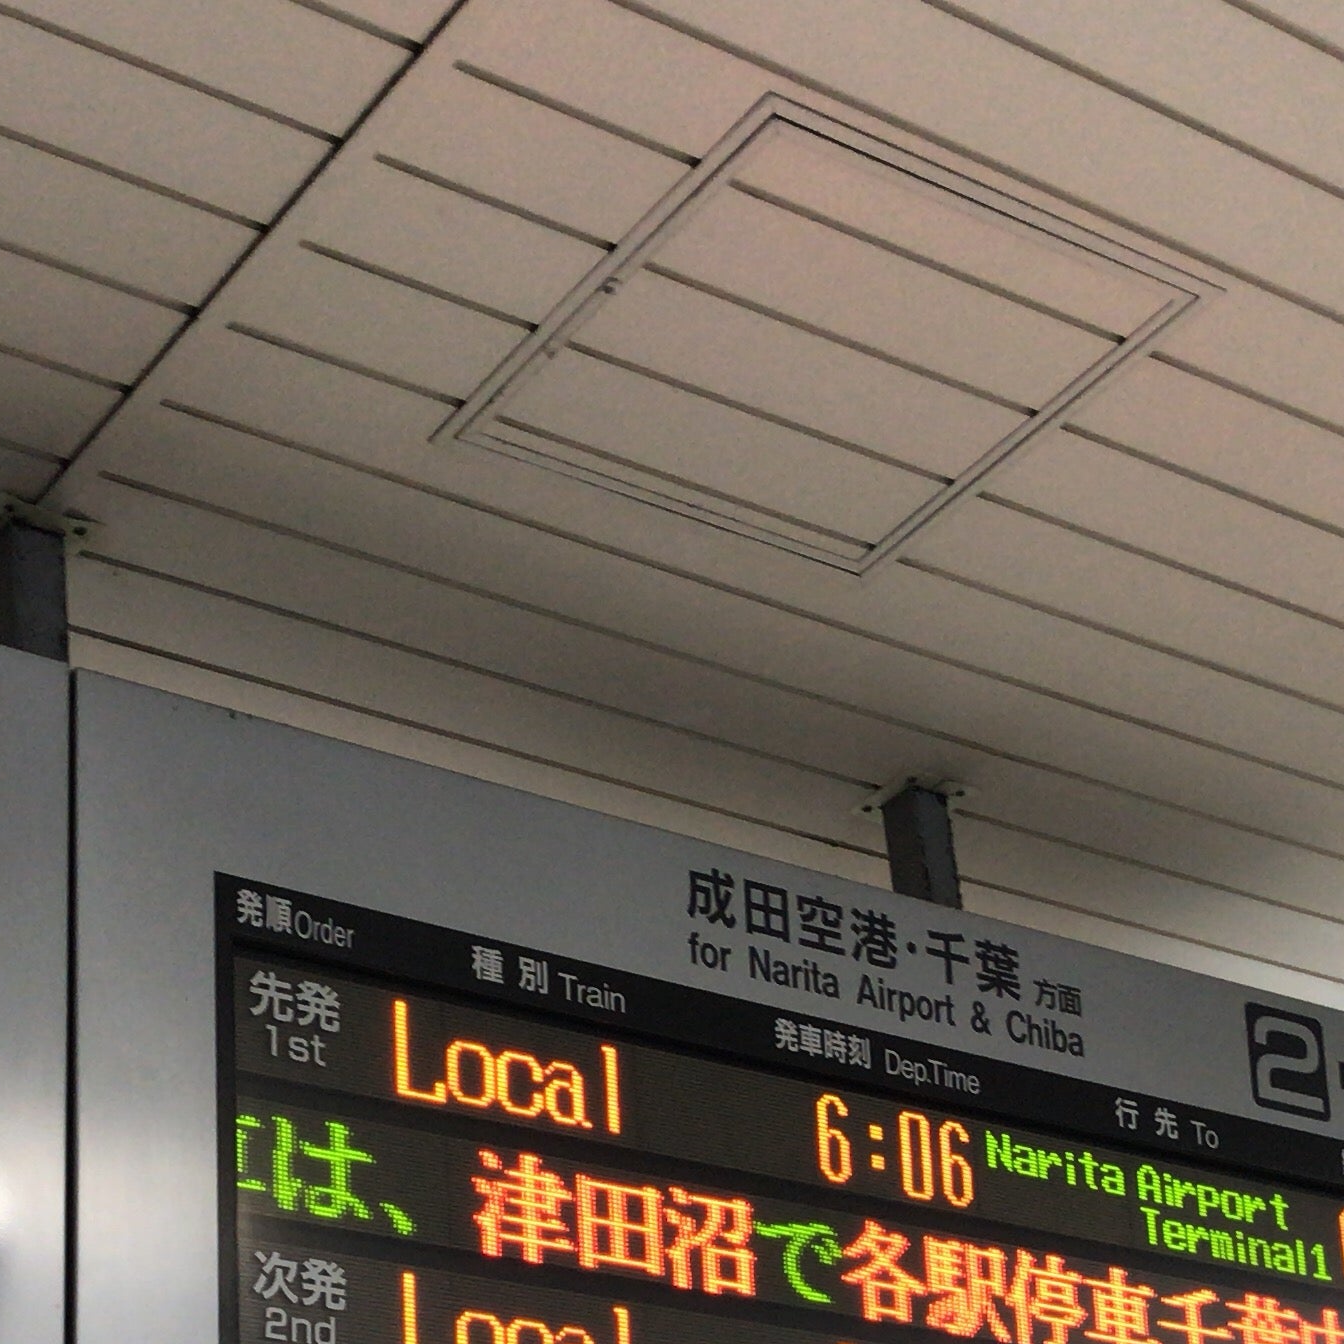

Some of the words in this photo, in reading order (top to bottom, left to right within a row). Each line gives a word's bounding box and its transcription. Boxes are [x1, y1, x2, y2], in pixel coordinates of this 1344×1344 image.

[249, 969, 341, 1033] 先発
[558, 971, 627, 1013] Train
[687, 931, 733, 971] for
[749, 945, 840, 999] Narita
[856, 974, 956, 1027] Airport
[971, 1000, 993, 1036] &
[1005, 1009, 1086, 1057] Chiba
[266, 1023, 327, 1067] 1st
[774, 1018, 872, 1070] 発車時刻
[885, 1047, 981, 1095] Dep.Time
[1254, 1014, 1327, 1116] 2
[393, 999, 622, 1135] Local
[815, 1093, 974, 1208] 6:06
[1191, 1120, 1219, 1149] To
[985, 1129, 1127, 1196] Narita
[1136, 1165, 1289, 1231] Airport
[253, 1250, 347, 1311] 次発
